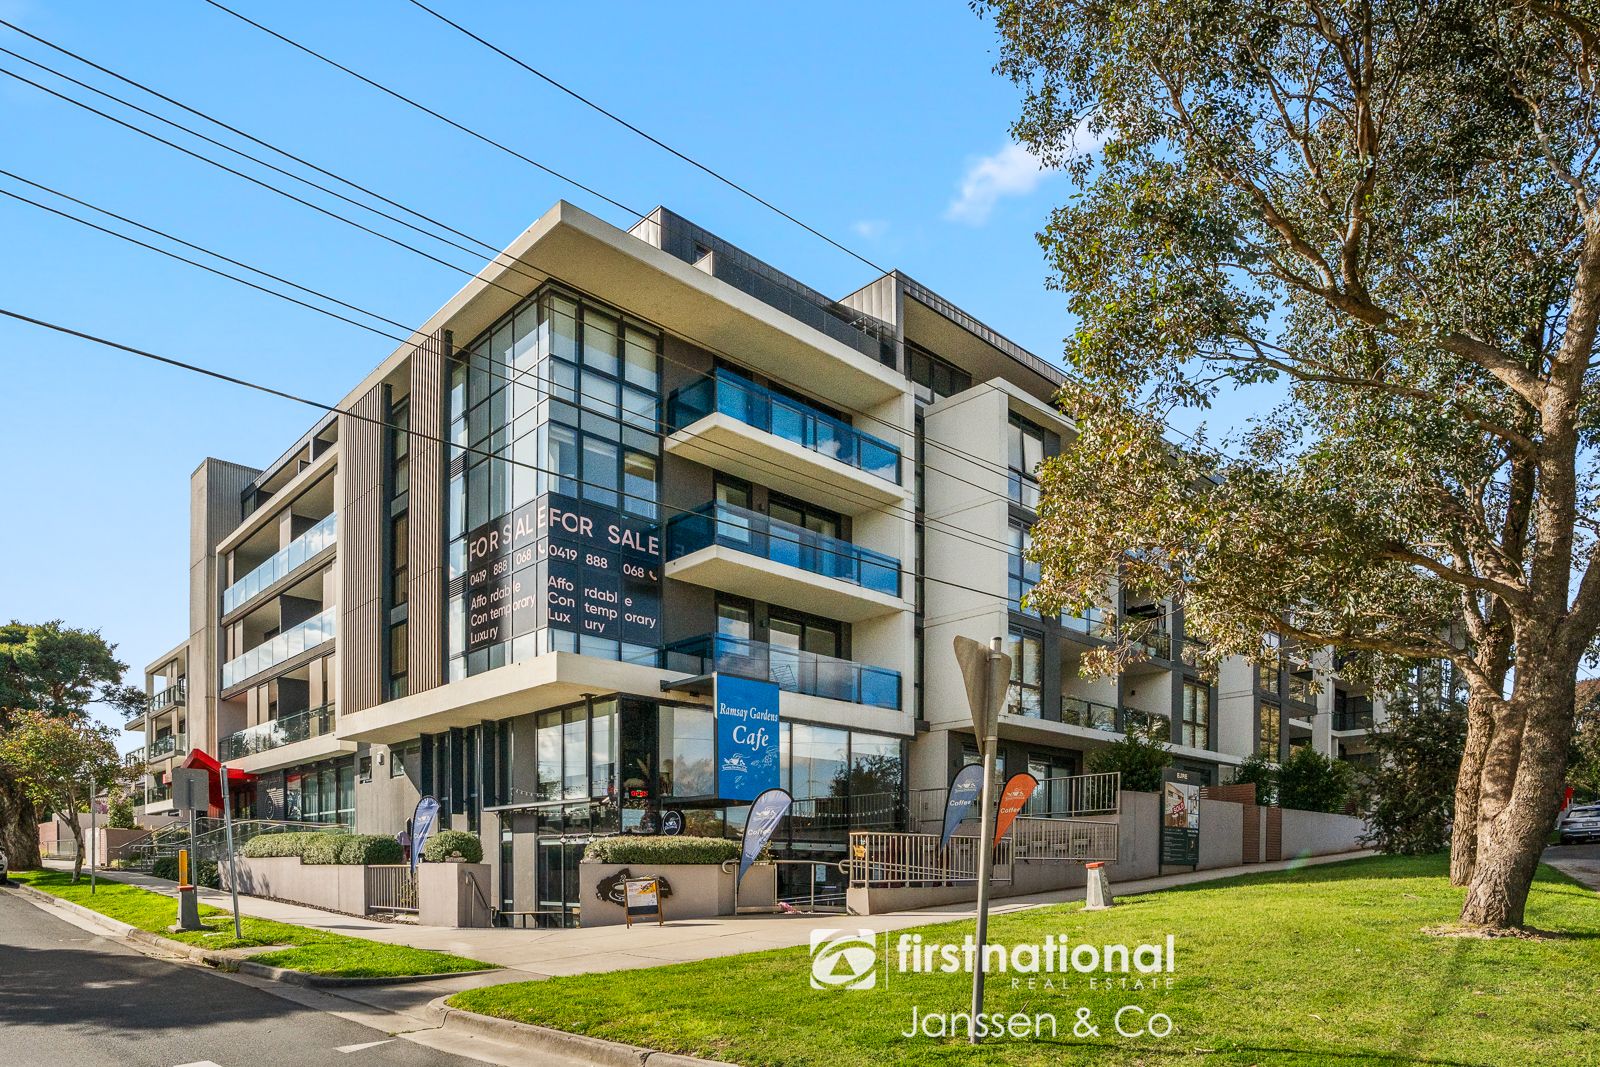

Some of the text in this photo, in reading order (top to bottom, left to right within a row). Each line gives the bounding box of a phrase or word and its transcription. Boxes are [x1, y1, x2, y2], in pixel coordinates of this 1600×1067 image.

[469, 506, 546, 562] FOR SALE
[549, 507, 659, 556] FOR SALE
[470, 548, 532, 586] 0419 888 068
[548, 544, 645, 578] 0419 888 068
[719, 702, 778, 722] Ramsay Gardens
[732, 725, 769, 751] Cafe
[1173, 802, 1185, 814] SOLD
